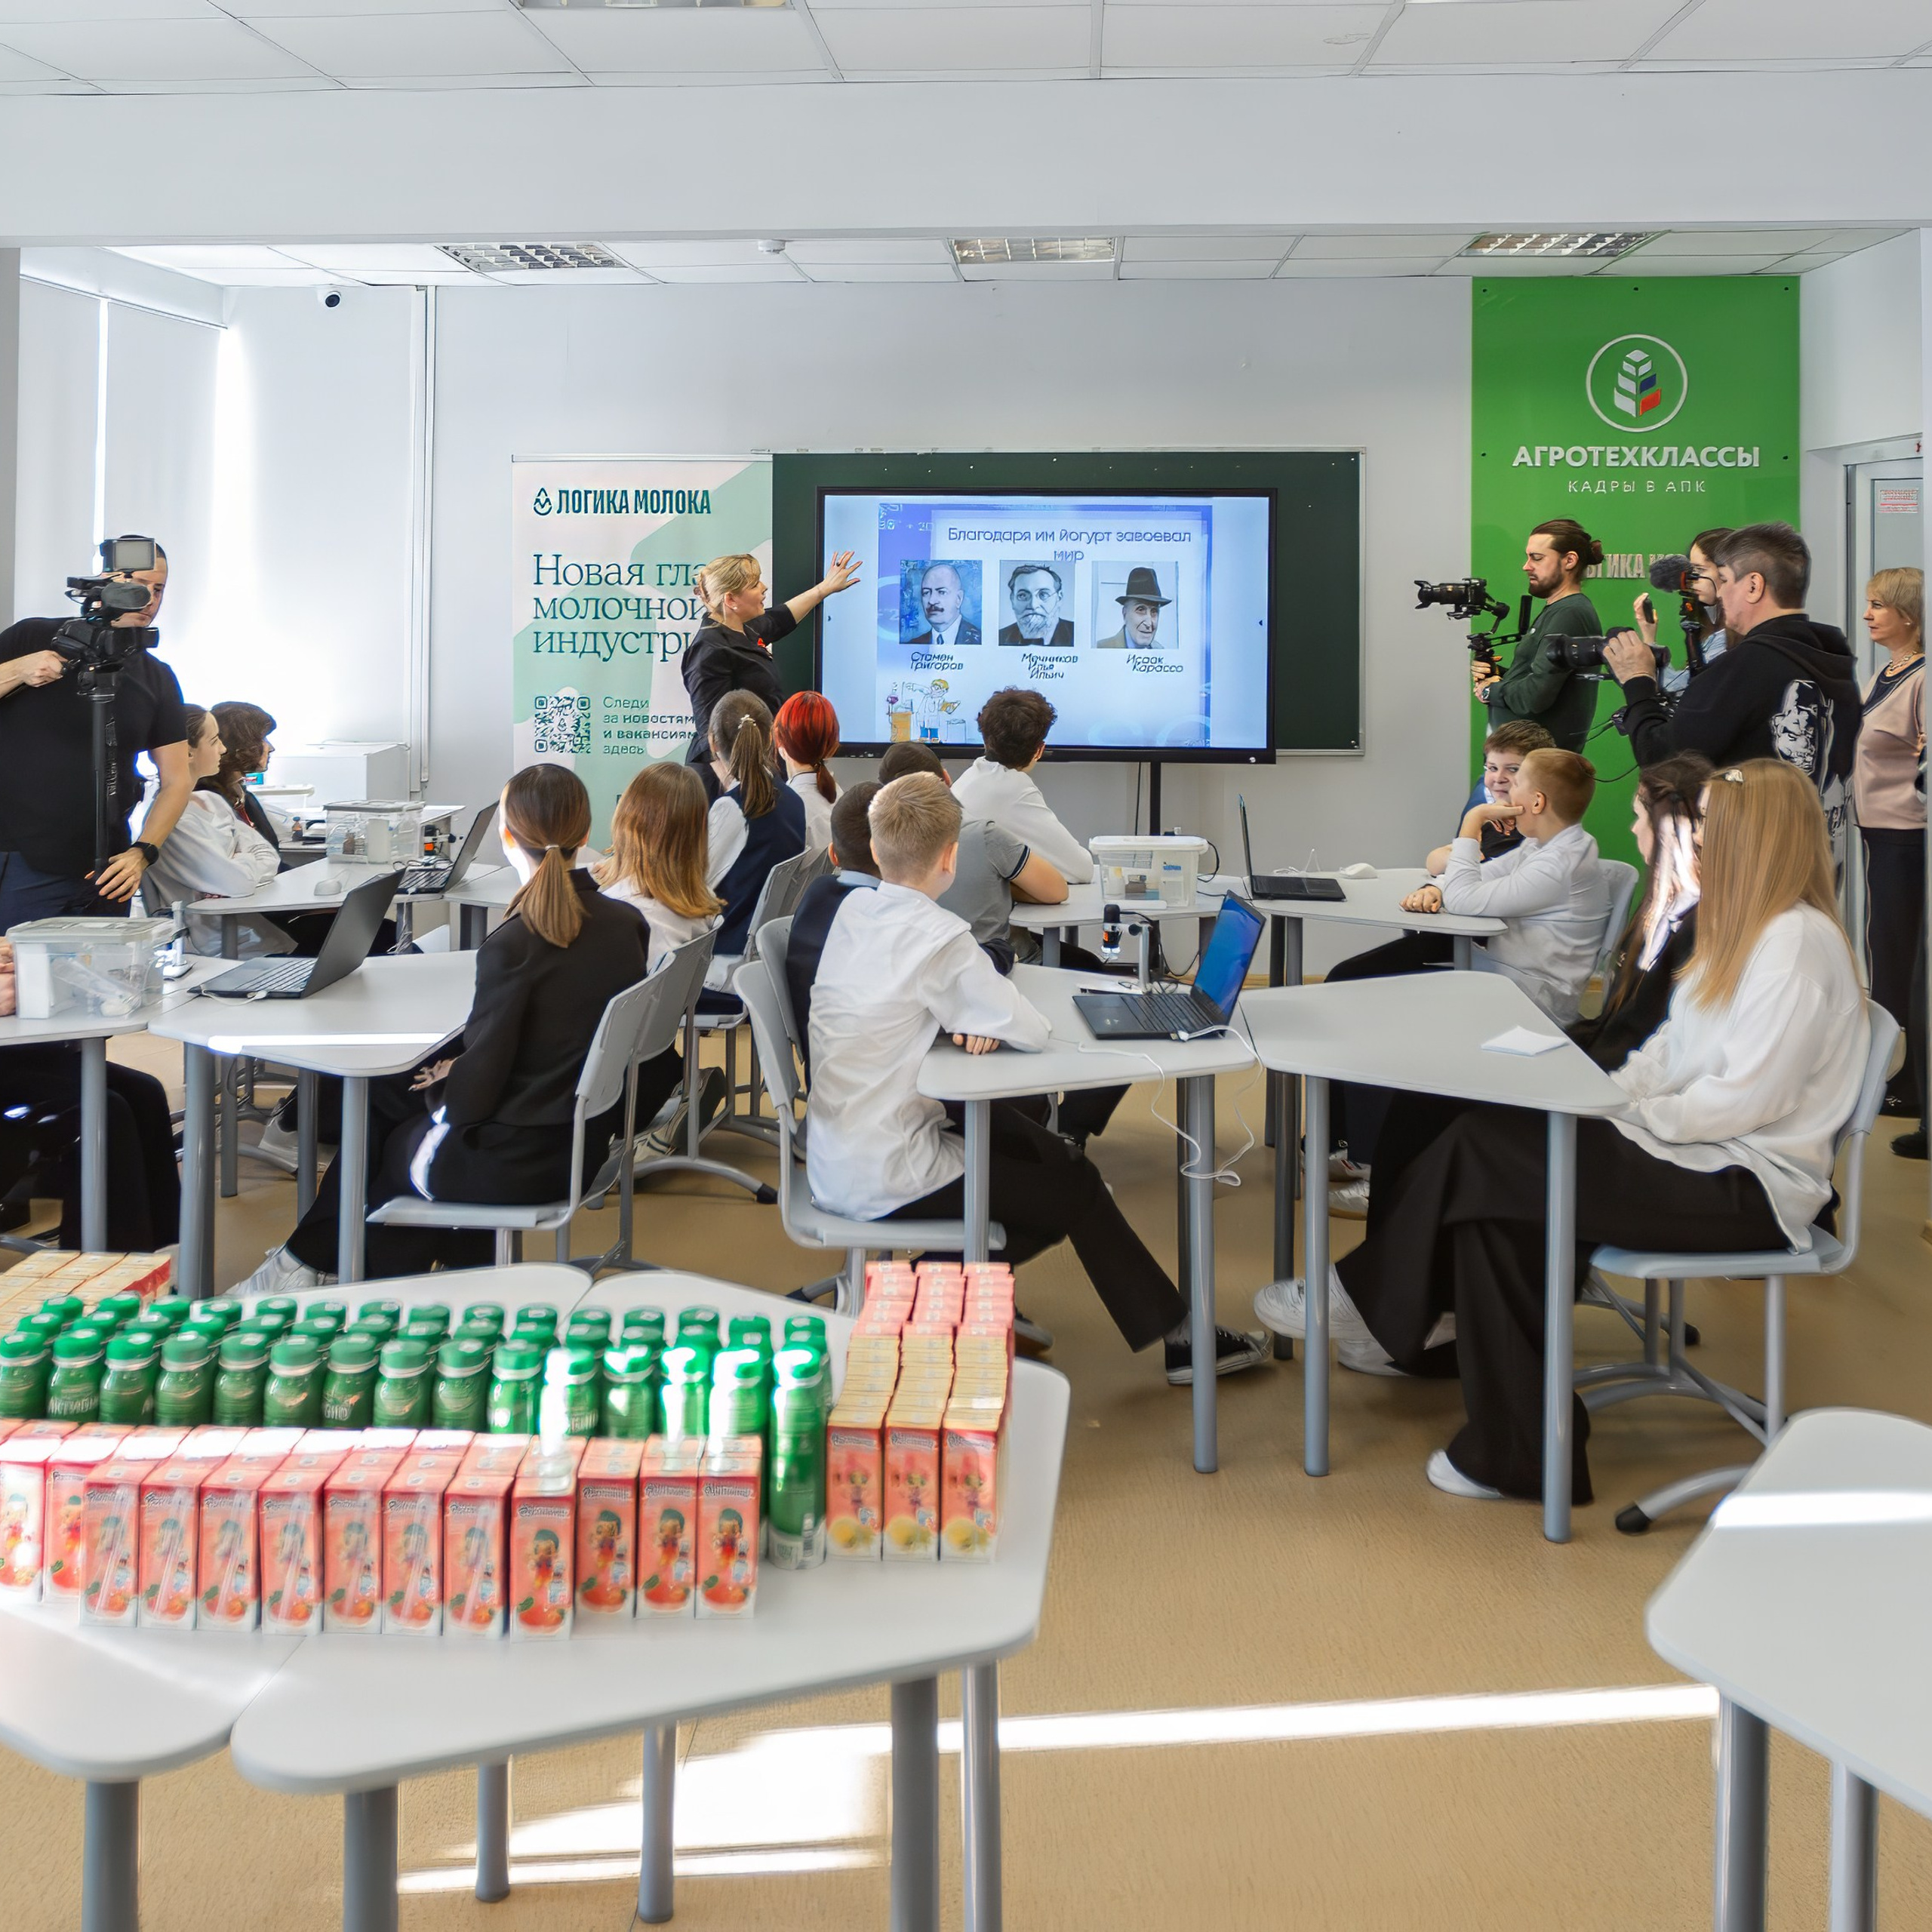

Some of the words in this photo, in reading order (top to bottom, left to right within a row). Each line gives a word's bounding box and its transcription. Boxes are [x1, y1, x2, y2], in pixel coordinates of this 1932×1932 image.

[1512, 445, 1760, 467] АГРОТЕХКЛАССЫ
[1568, 481, 1635, 494] КАДРЫ
[1646, 481, 1655, 492] В
[1665, 481, 1706, 493] АПК
[556, 489, 630, 515] ЛОГИКА
[634, 489, 712, 515] МОЛОКА
[948, 527, 1032, 544] Благодаря
[1035, 531, 1055, 542] им
[1059, 528, 1112, 545] йогурт
[1115, 531, 1192, 543] завоевал
[1054, 549, 1085, 562] мир
[533, 554, 645, 586] Новая
[603, 696, 650, 709] Следи
[603, 715, 618, 724] за
[603, 730, 612, 739] и
[603, 745, 645, 755] здесь
